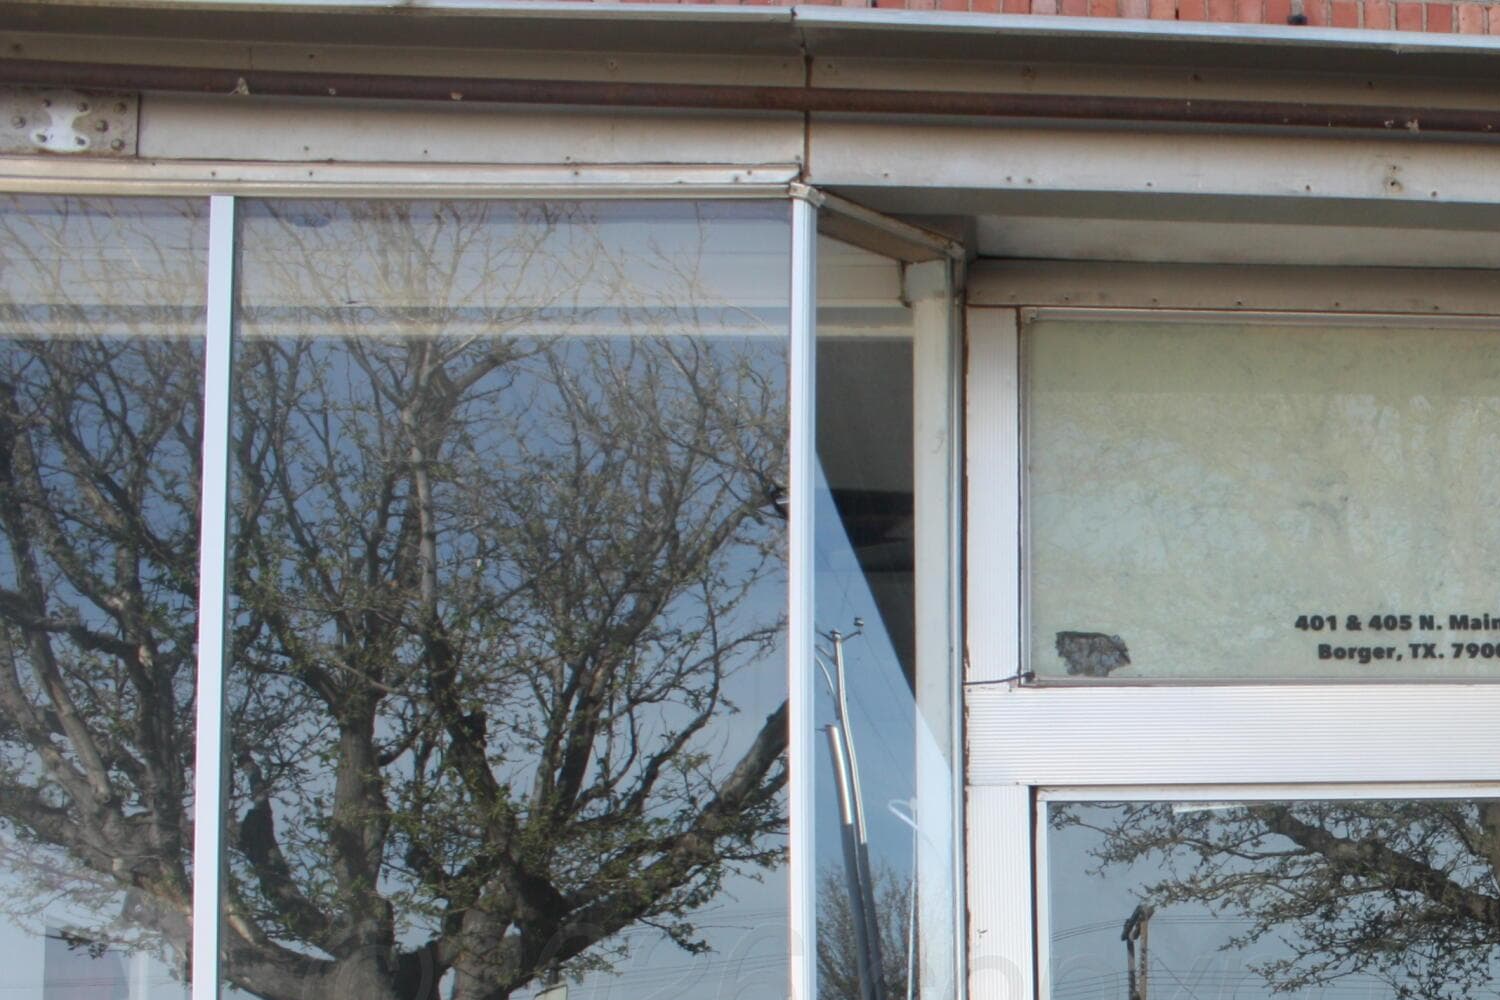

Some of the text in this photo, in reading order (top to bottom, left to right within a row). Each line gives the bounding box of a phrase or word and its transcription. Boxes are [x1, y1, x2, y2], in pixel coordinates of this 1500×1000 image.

[1294, 614, 1338, 631] 401
[1346, 614, 1362, 631] &
[1368, 614, 1413, 631] 405
[1419, 614, 1443, 631] N.
[1317, 643, 1403, 664] Borger,
[1408, 643, 1445, 660] TX.
